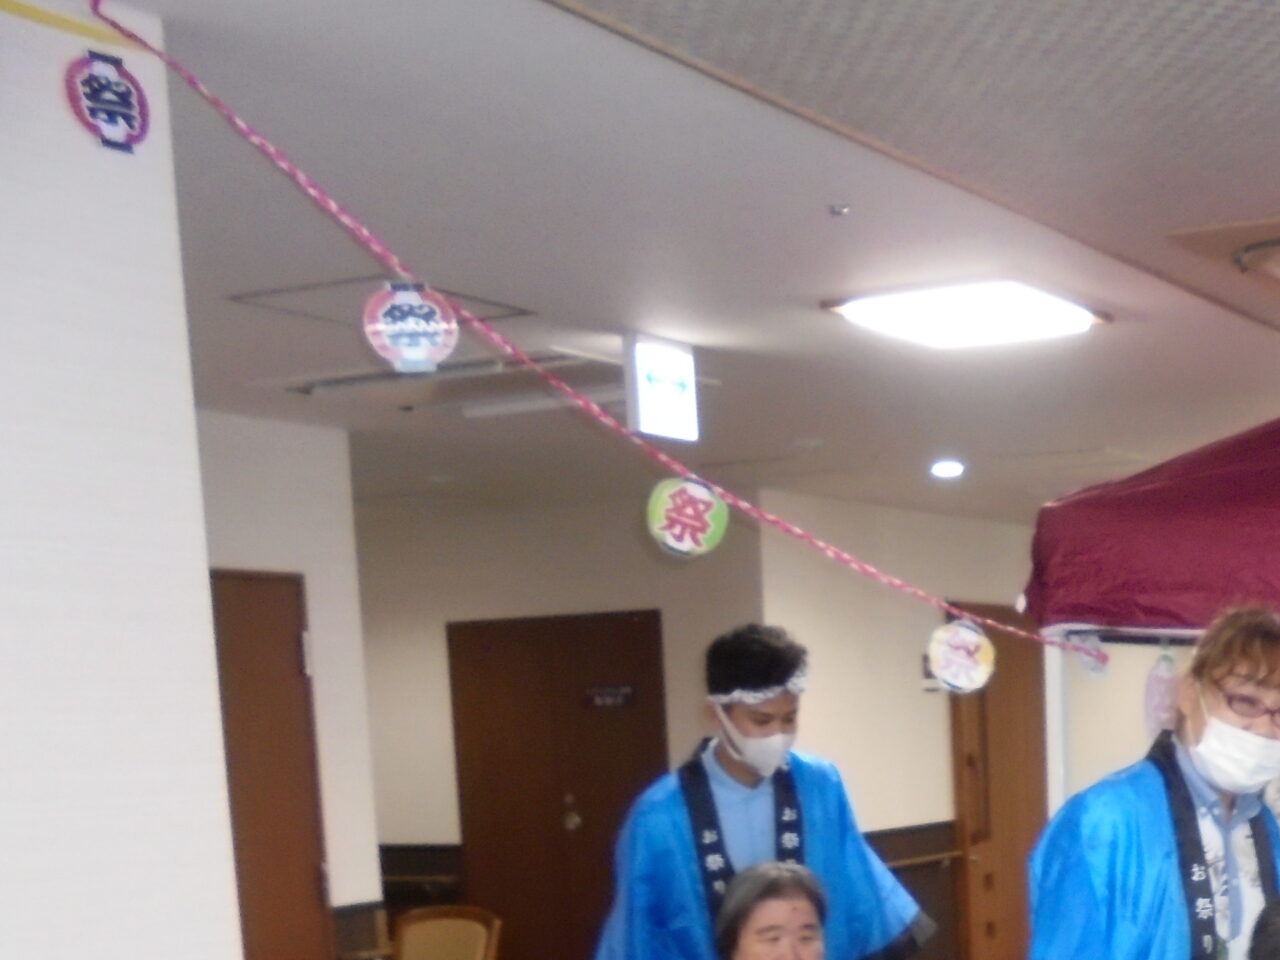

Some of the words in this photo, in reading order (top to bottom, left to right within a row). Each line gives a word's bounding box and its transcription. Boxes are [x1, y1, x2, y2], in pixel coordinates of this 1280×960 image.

[81, 73, 137, 131] 祭
[661, 487, 713, 548] 祭
[1191, 863, 1214, 954] お祭り
